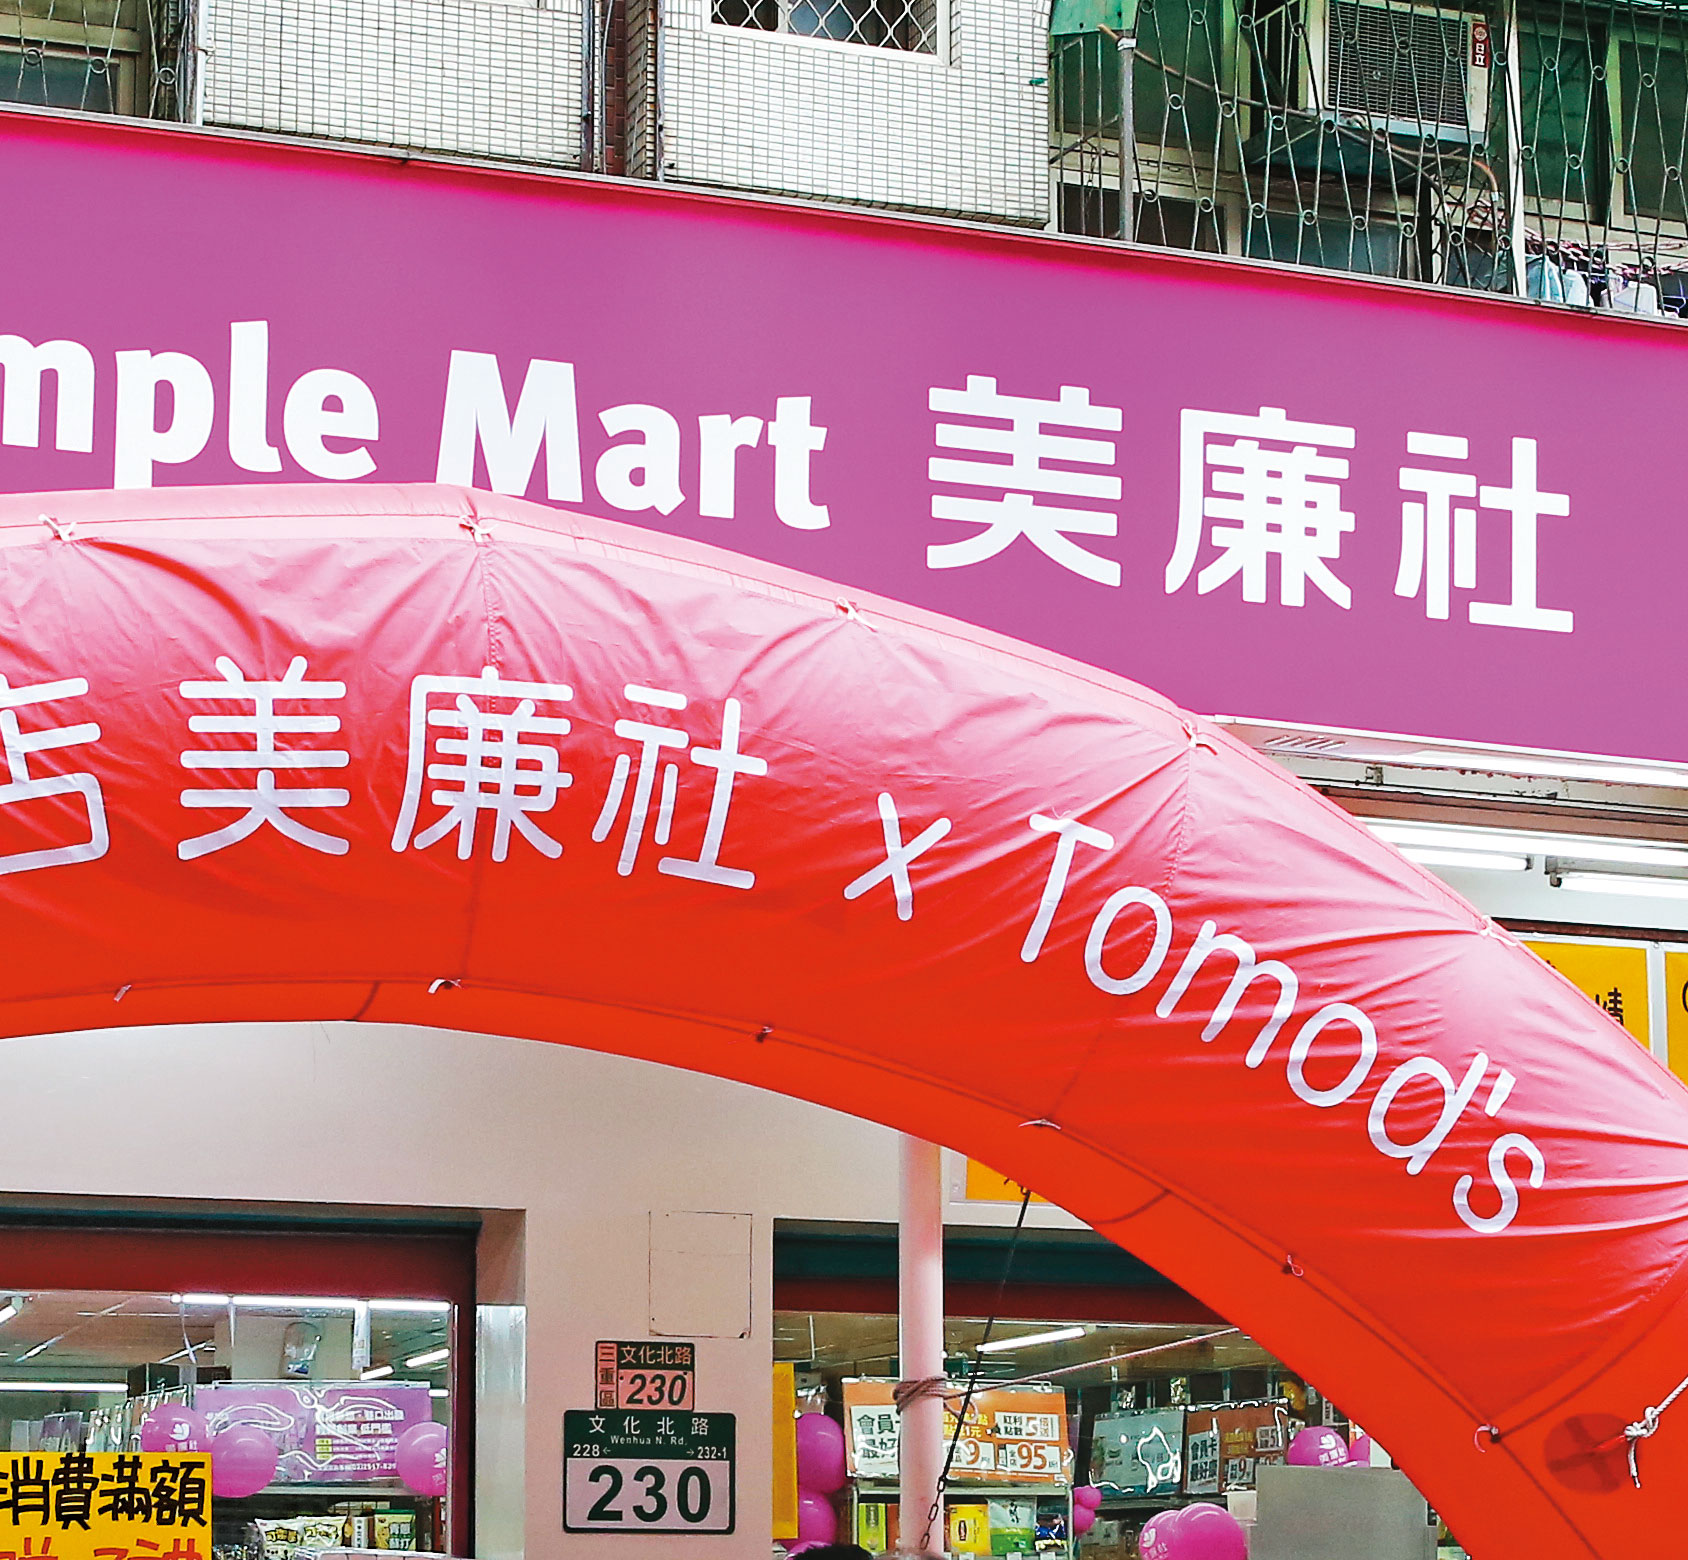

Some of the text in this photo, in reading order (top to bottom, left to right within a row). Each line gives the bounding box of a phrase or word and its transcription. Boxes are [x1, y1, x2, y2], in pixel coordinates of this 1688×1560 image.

[435, 349, 833, 530] Mart
[927, 374, 1575, 635] 美廉社
[177, 654, 769, 890] 美廉社
[1019, 812, 1547, 1235] Tomod's
[620, 1345, 692, 1366] 文化北路
[598, 1345, 616, 1407] 三重區
[626, 1373, 687, 1406] 230
[588, 1414, 709, 1436] 文化北路
[1025, 1416, 1039, 1437] 5
[572, 1443, 601, 1457] 228
[610, 1434, 652, 1446] Wenhua
[670, 1436, 688, 1447] Rd.
[1017, 1443, 1048, 1470] 95
[586, 1464, 712, 1524] 230
